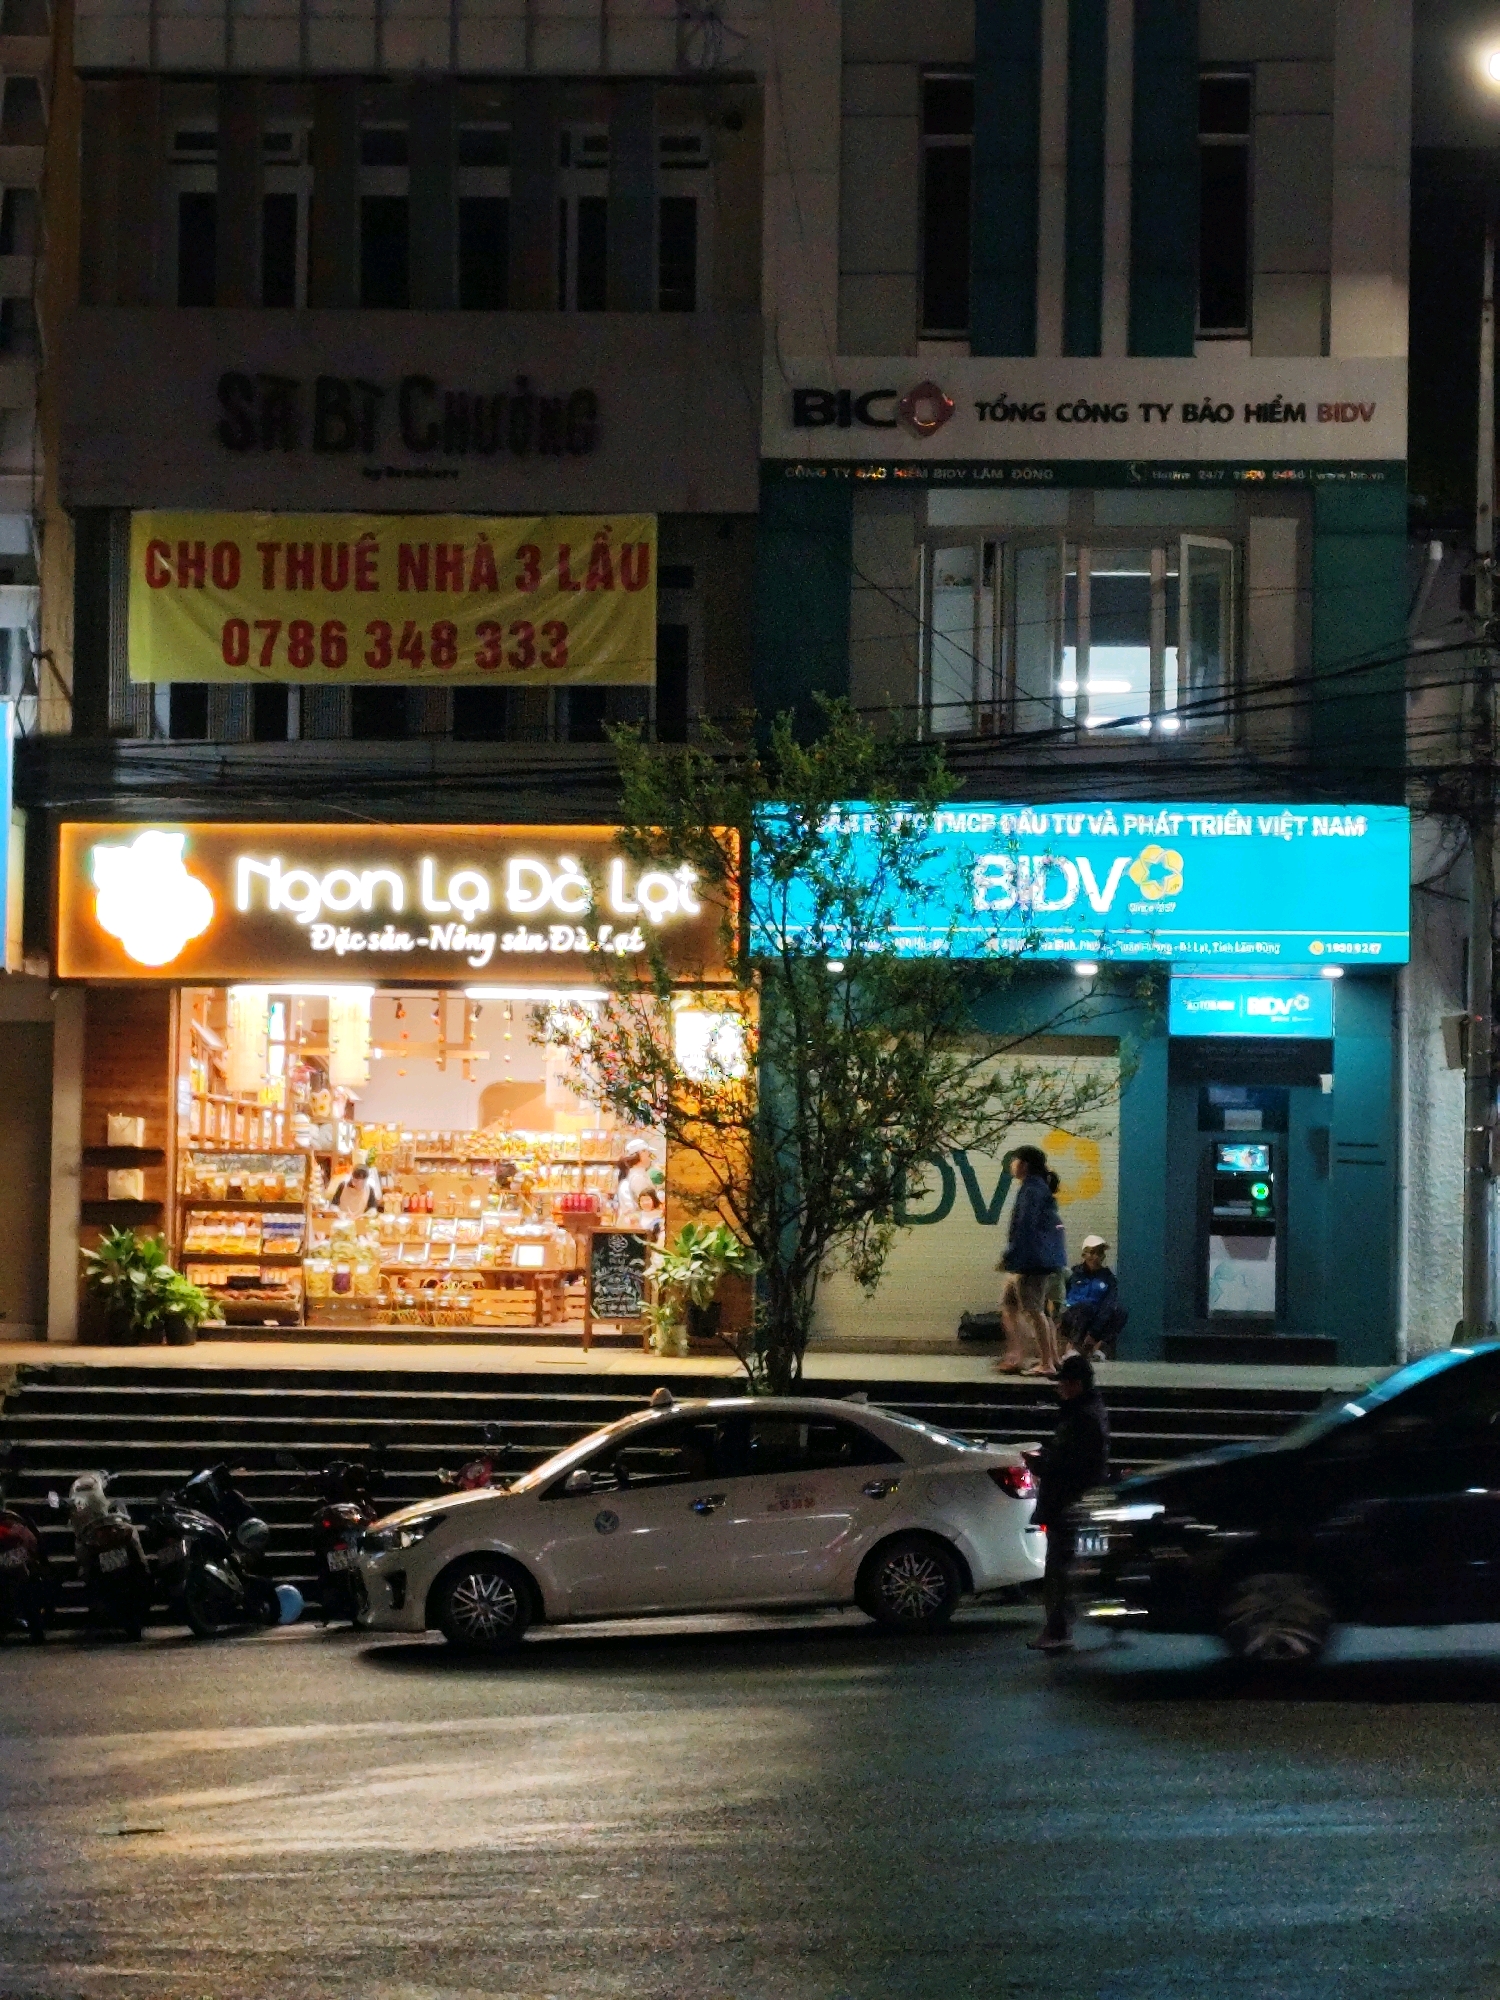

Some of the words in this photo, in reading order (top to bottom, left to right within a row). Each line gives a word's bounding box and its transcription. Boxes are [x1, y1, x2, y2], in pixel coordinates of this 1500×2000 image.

[974, 391, 1046, 422] TỔNG
[1056, 398, 1128, 423] CÔNG
[1138, 403, 1173, 422] TY
[1182, 397, 1234, 423] BẢO
[1244, 394, 1306, 423] HIỂM
[1316, 402, 1376, 423] BIDV
[833, 467, 850, 478] TY
[933, 468, 966, 479] BIDV
[145, 539, 241, 590] CHO
[257, 532, 380, 592] THUÊ
[397, 532, 498, 592] NHÀ
[515, 543, 541, 593] 3
[558, 525, 650, 592] LẦU
[221, 618, 348, 669] 0786
[364, 619, 458, 669] 348
[474, 620, 569, 670] 333
[934, 811, 996, 834] TMCP
[1088, 810, 1119, 836] VÀ
[1123, 810, 1184, 837] PHÁT
[1187, 808, 1253, 837] TRIỂN
[1257, 811, 1309, 841] VIỆT
[1312, 816, 1366, 838] NAM
[237, 856, 404, 924] Ngon
[422, 858, 490, 922] Lạ
[506, 857, 592, 913] Đà
[610, 858, 700, 923] Lạt
[974, 856, 1131, 912] BIDV
[311, 924, 367, 956] Đặc
[1247, 997, 1294, 1016] BIDV
[850, 1149, 1022, 1226] DV
